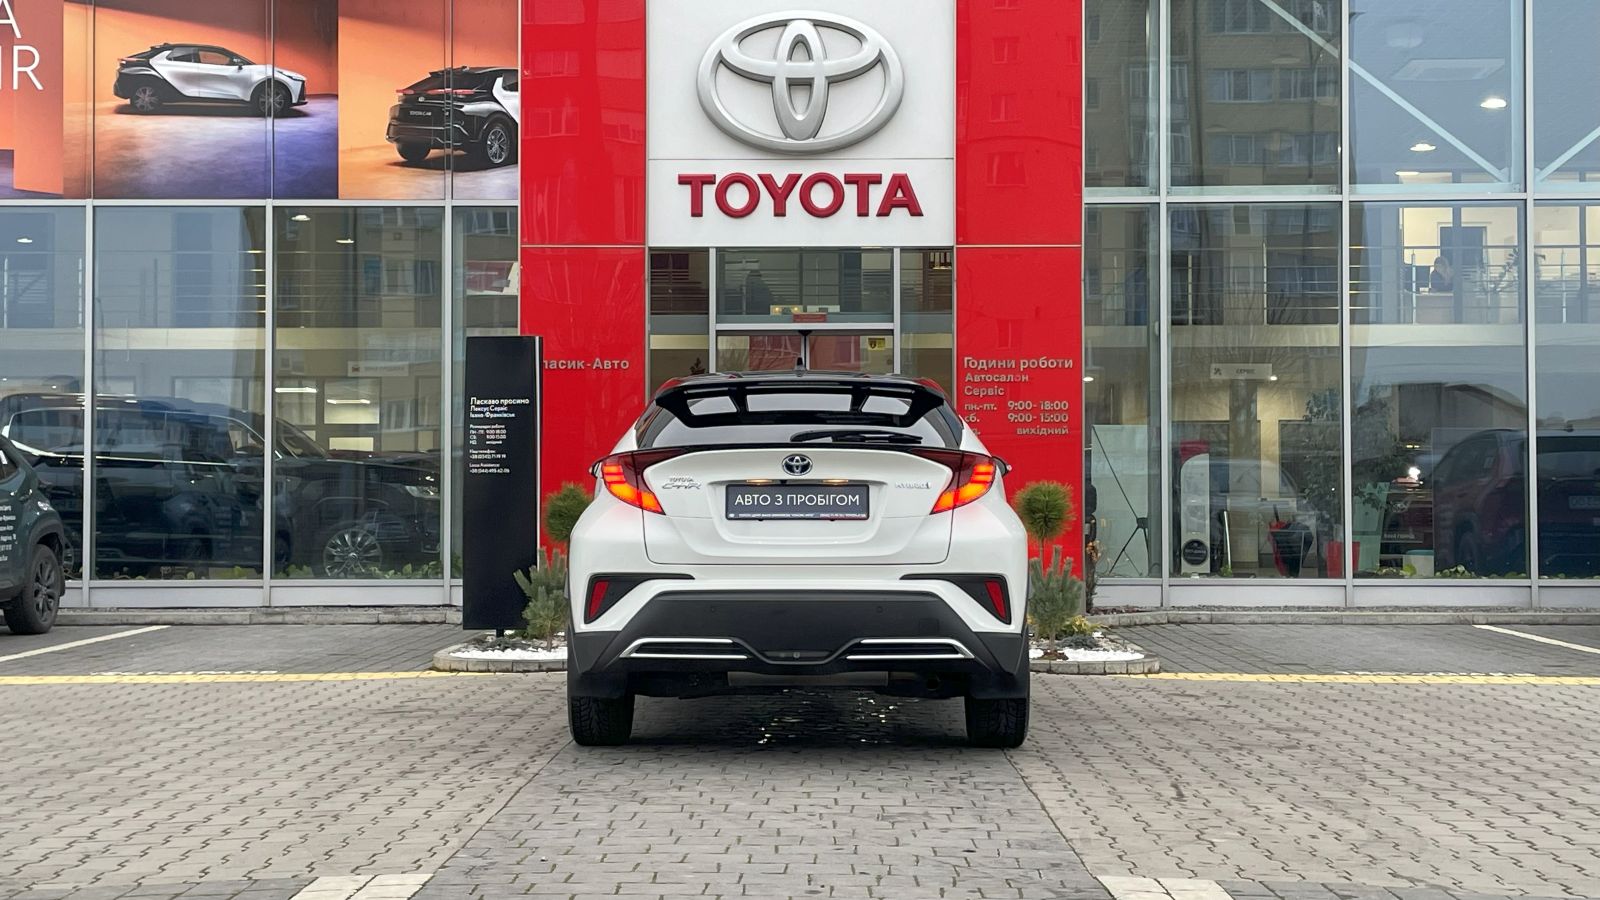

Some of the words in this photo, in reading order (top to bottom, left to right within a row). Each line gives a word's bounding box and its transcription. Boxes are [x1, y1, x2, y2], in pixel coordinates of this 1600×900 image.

[678, 172, 924, 219] TOYOTA
[963, 357, 1015, 371] Години
[1020, 356, 1073, 372] роботи
[965, 372, 1029, 383] Автосалон
[964, 385, 1005, 397] Сервіс
[1017, 425, 1069, 436] вихідний
[734, 494, 771, 506] АВТО
[787, 494, 860, 506] ПРОБІГОМ
